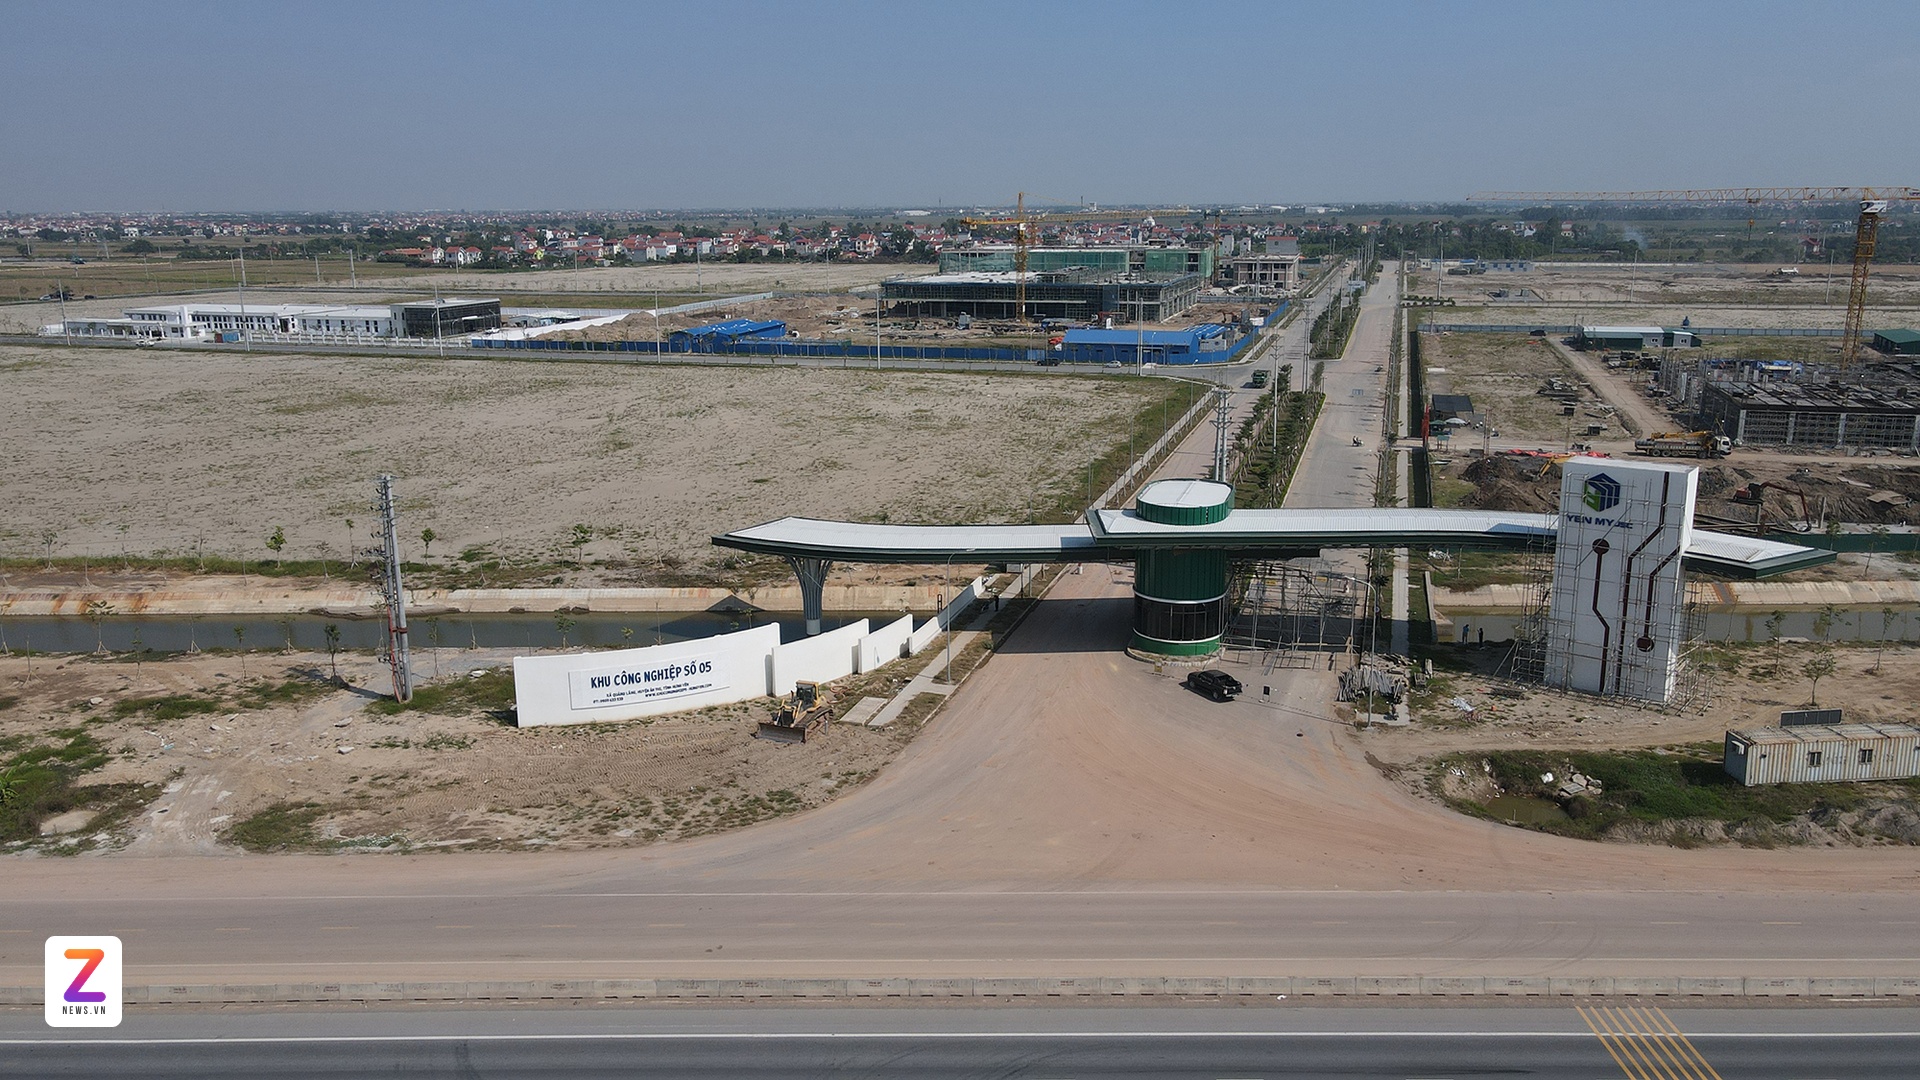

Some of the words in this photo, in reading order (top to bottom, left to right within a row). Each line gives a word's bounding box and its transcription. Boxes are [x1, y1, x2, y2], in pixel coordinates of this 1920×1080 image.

[1566, 515, 1592, 524] YEN
[1595, 517, 1615, 526] MY
[590, 675, 611, 689] KHU
[613, 670, 641, 686] CÔNG
[644, 664, 682, 682] NGHIỆP
[684, 660, 697, 677] SỐ
[699, 661, 712, 673] 05
